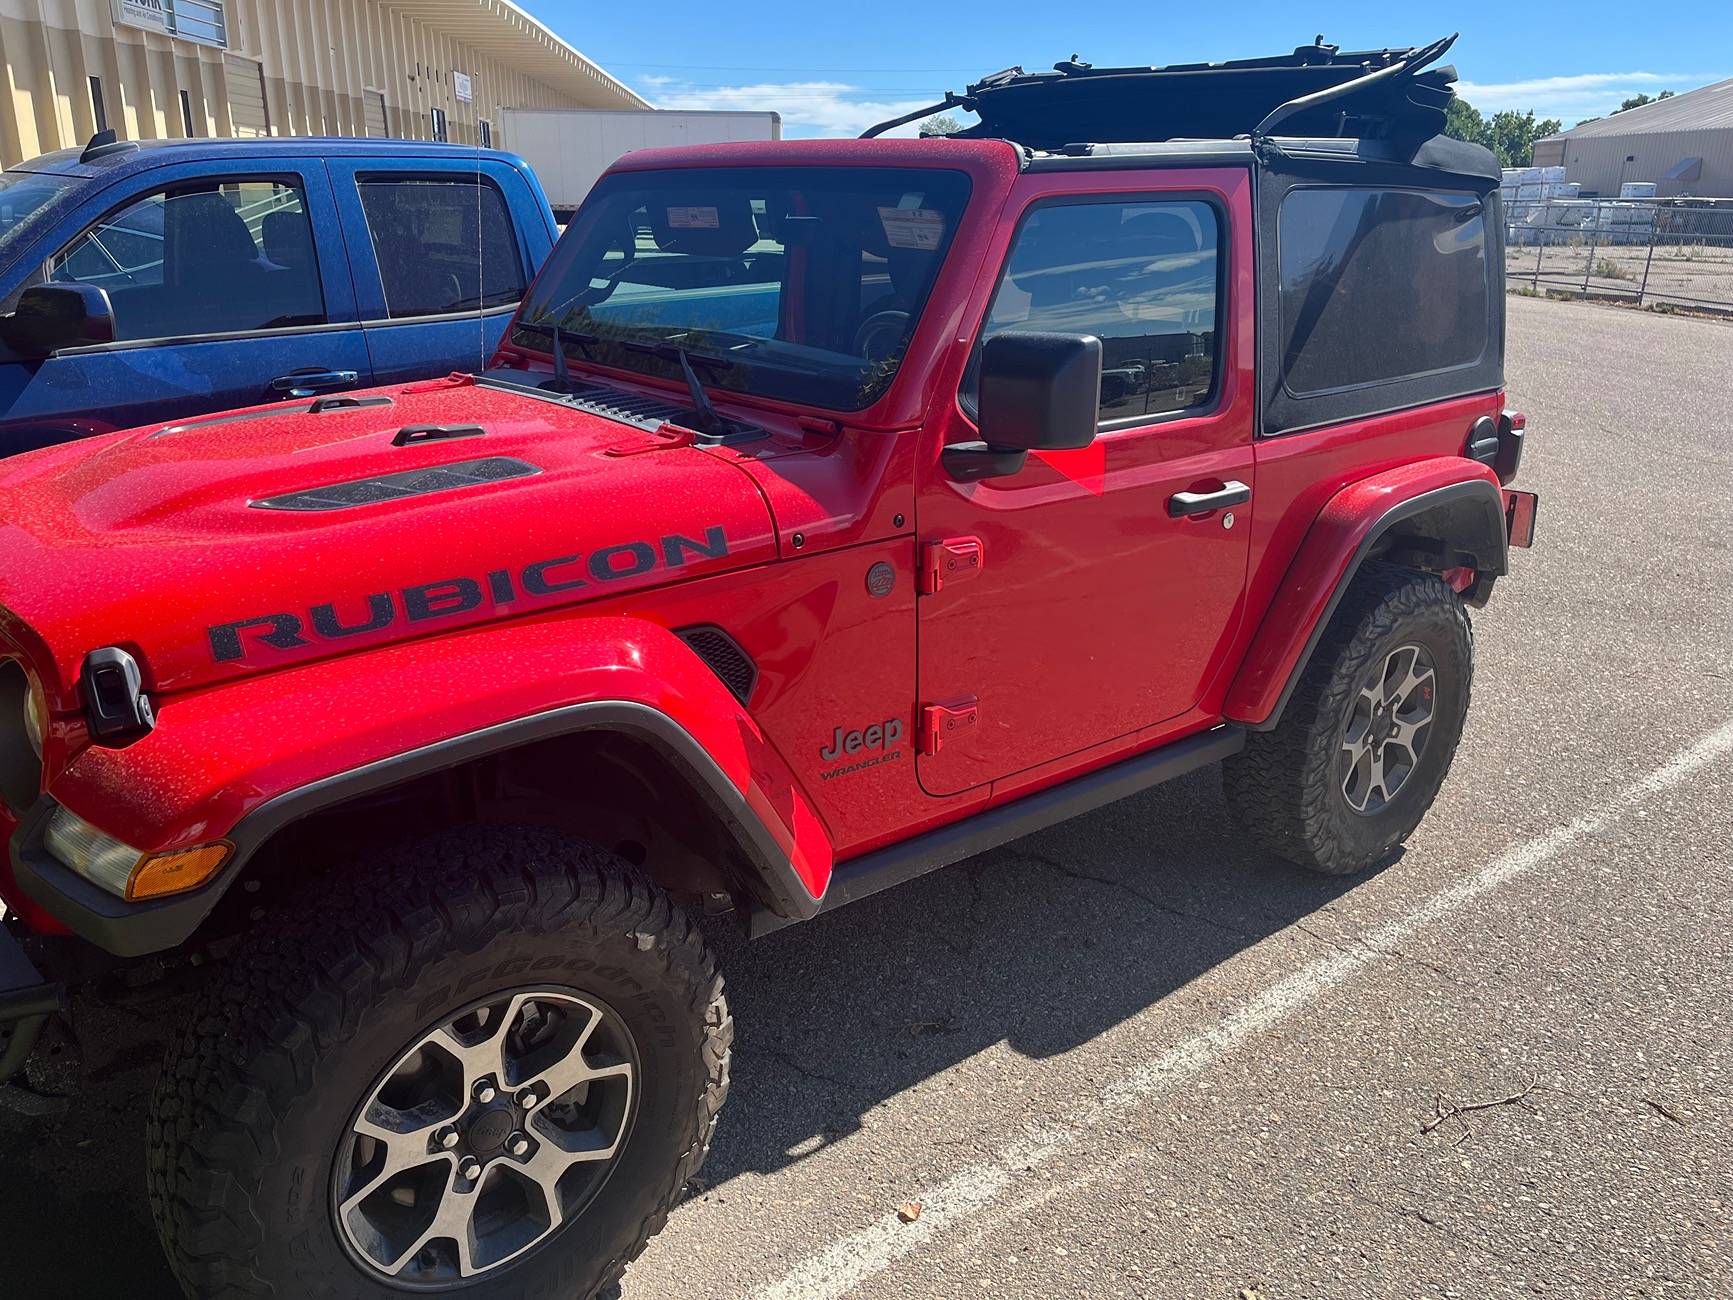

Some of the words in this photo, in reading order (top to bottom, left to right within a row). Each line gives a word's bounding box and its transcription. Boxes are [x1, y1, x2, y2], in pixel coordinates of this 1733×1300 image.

[209, 526, 729, 661] RUBICON
[820, 718, 902, 760] Jeep
[821, 751, 901, 780] WRANGLER
